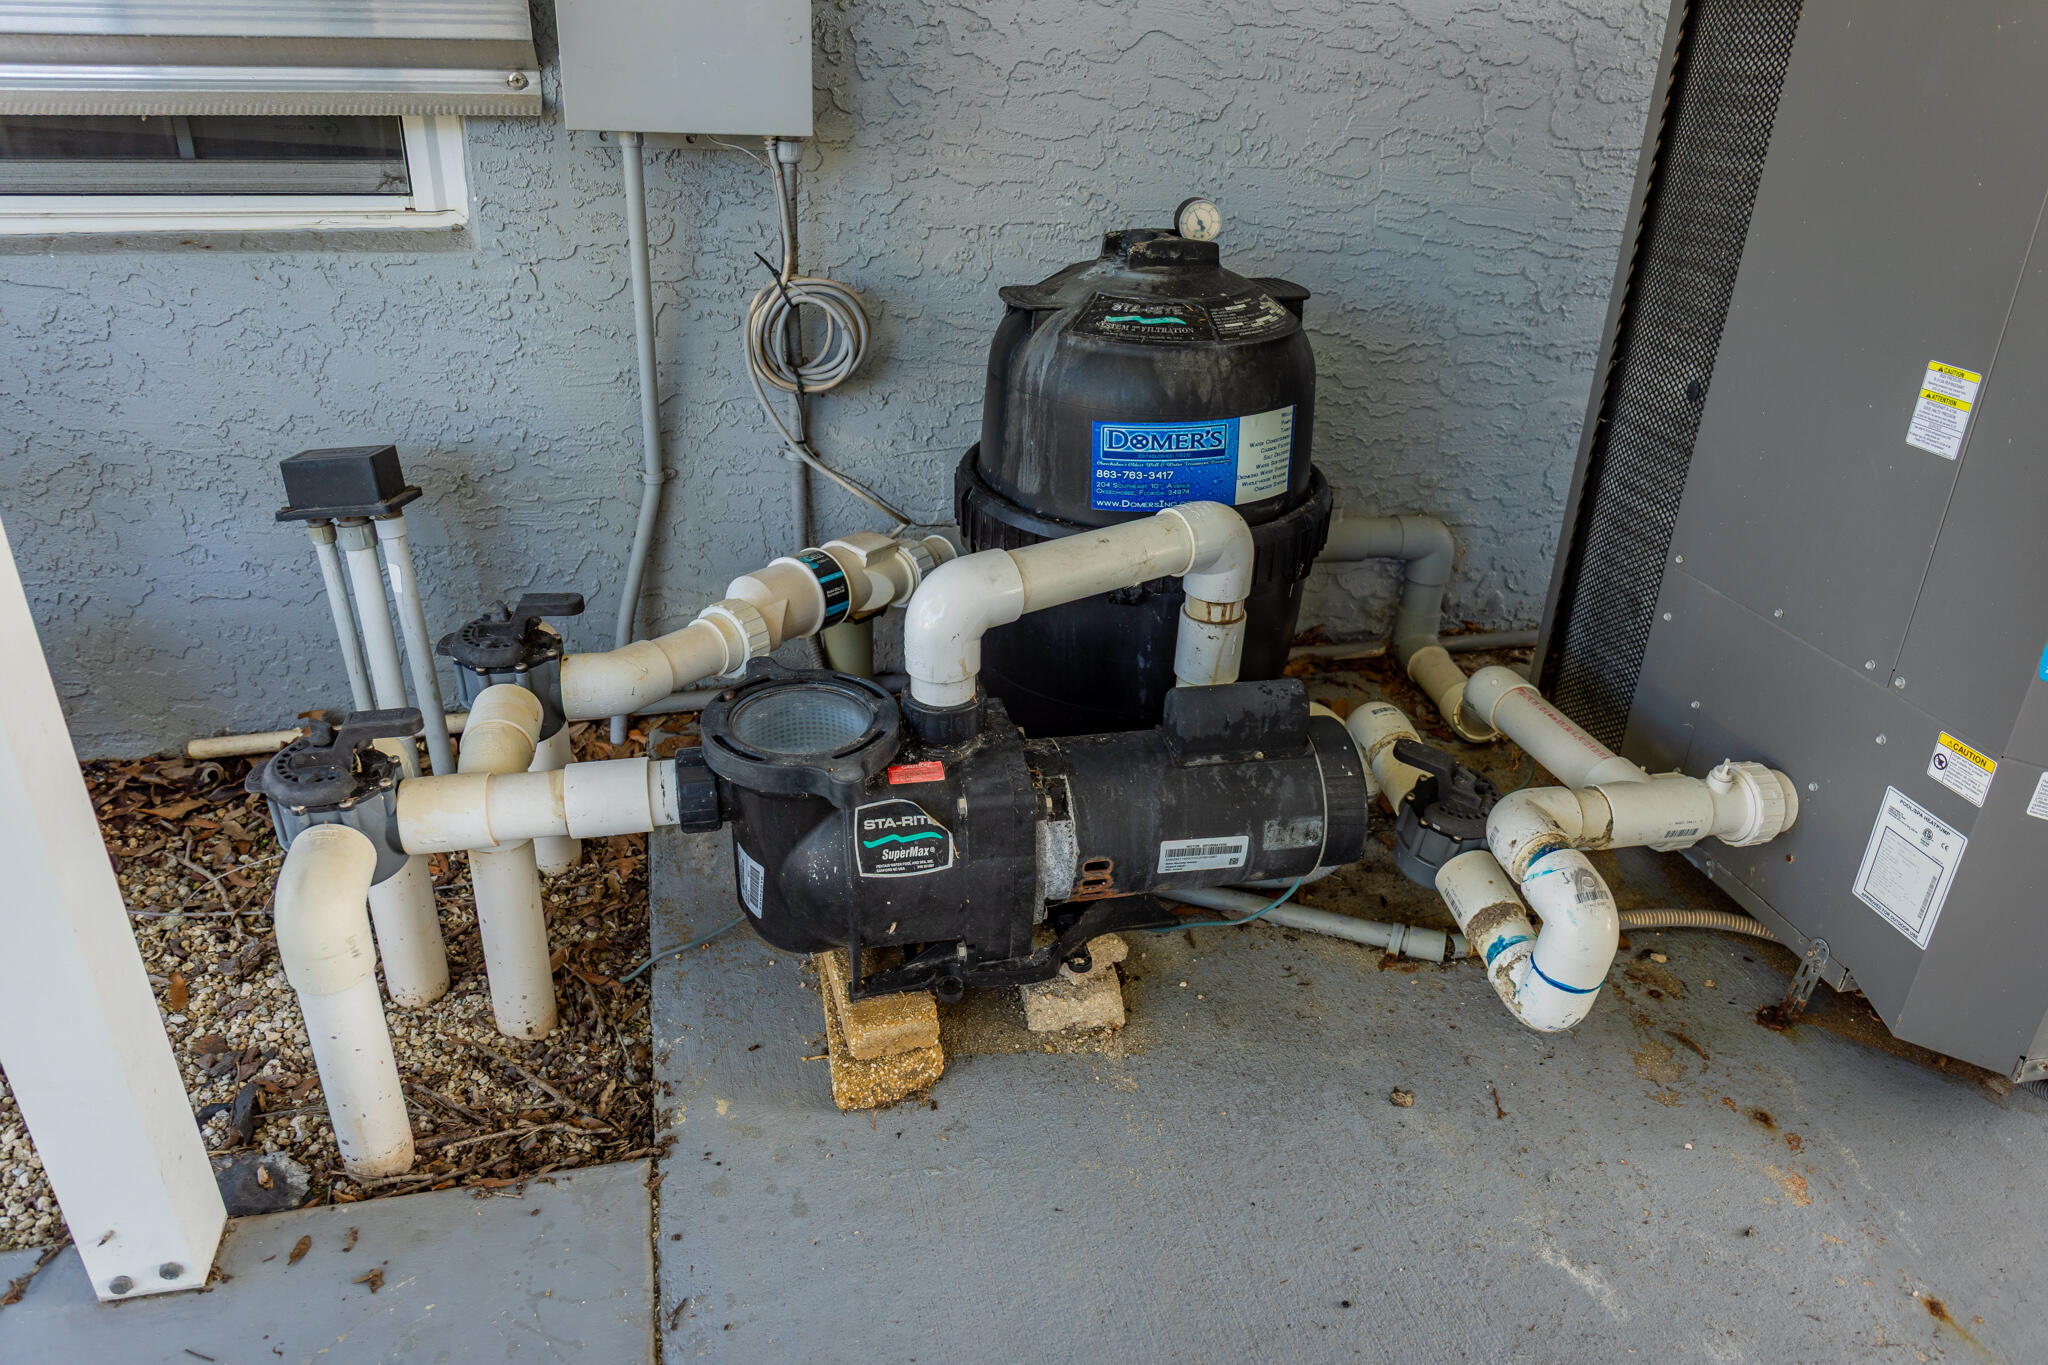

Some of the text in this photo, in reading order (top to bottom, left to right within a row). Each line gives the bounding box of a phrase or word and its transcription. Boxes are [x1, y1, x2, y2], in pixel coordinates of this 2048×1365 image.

[1142, 326, 1195, 334] FILTRATION
[1943, 367, 1965, 379] CAUTION
[1931, 393, 1957, 407] ATTENTION
[1096, 469, 1174, 480] 863-763-3417
[1953, 743, 1987, 768] CAUTION
